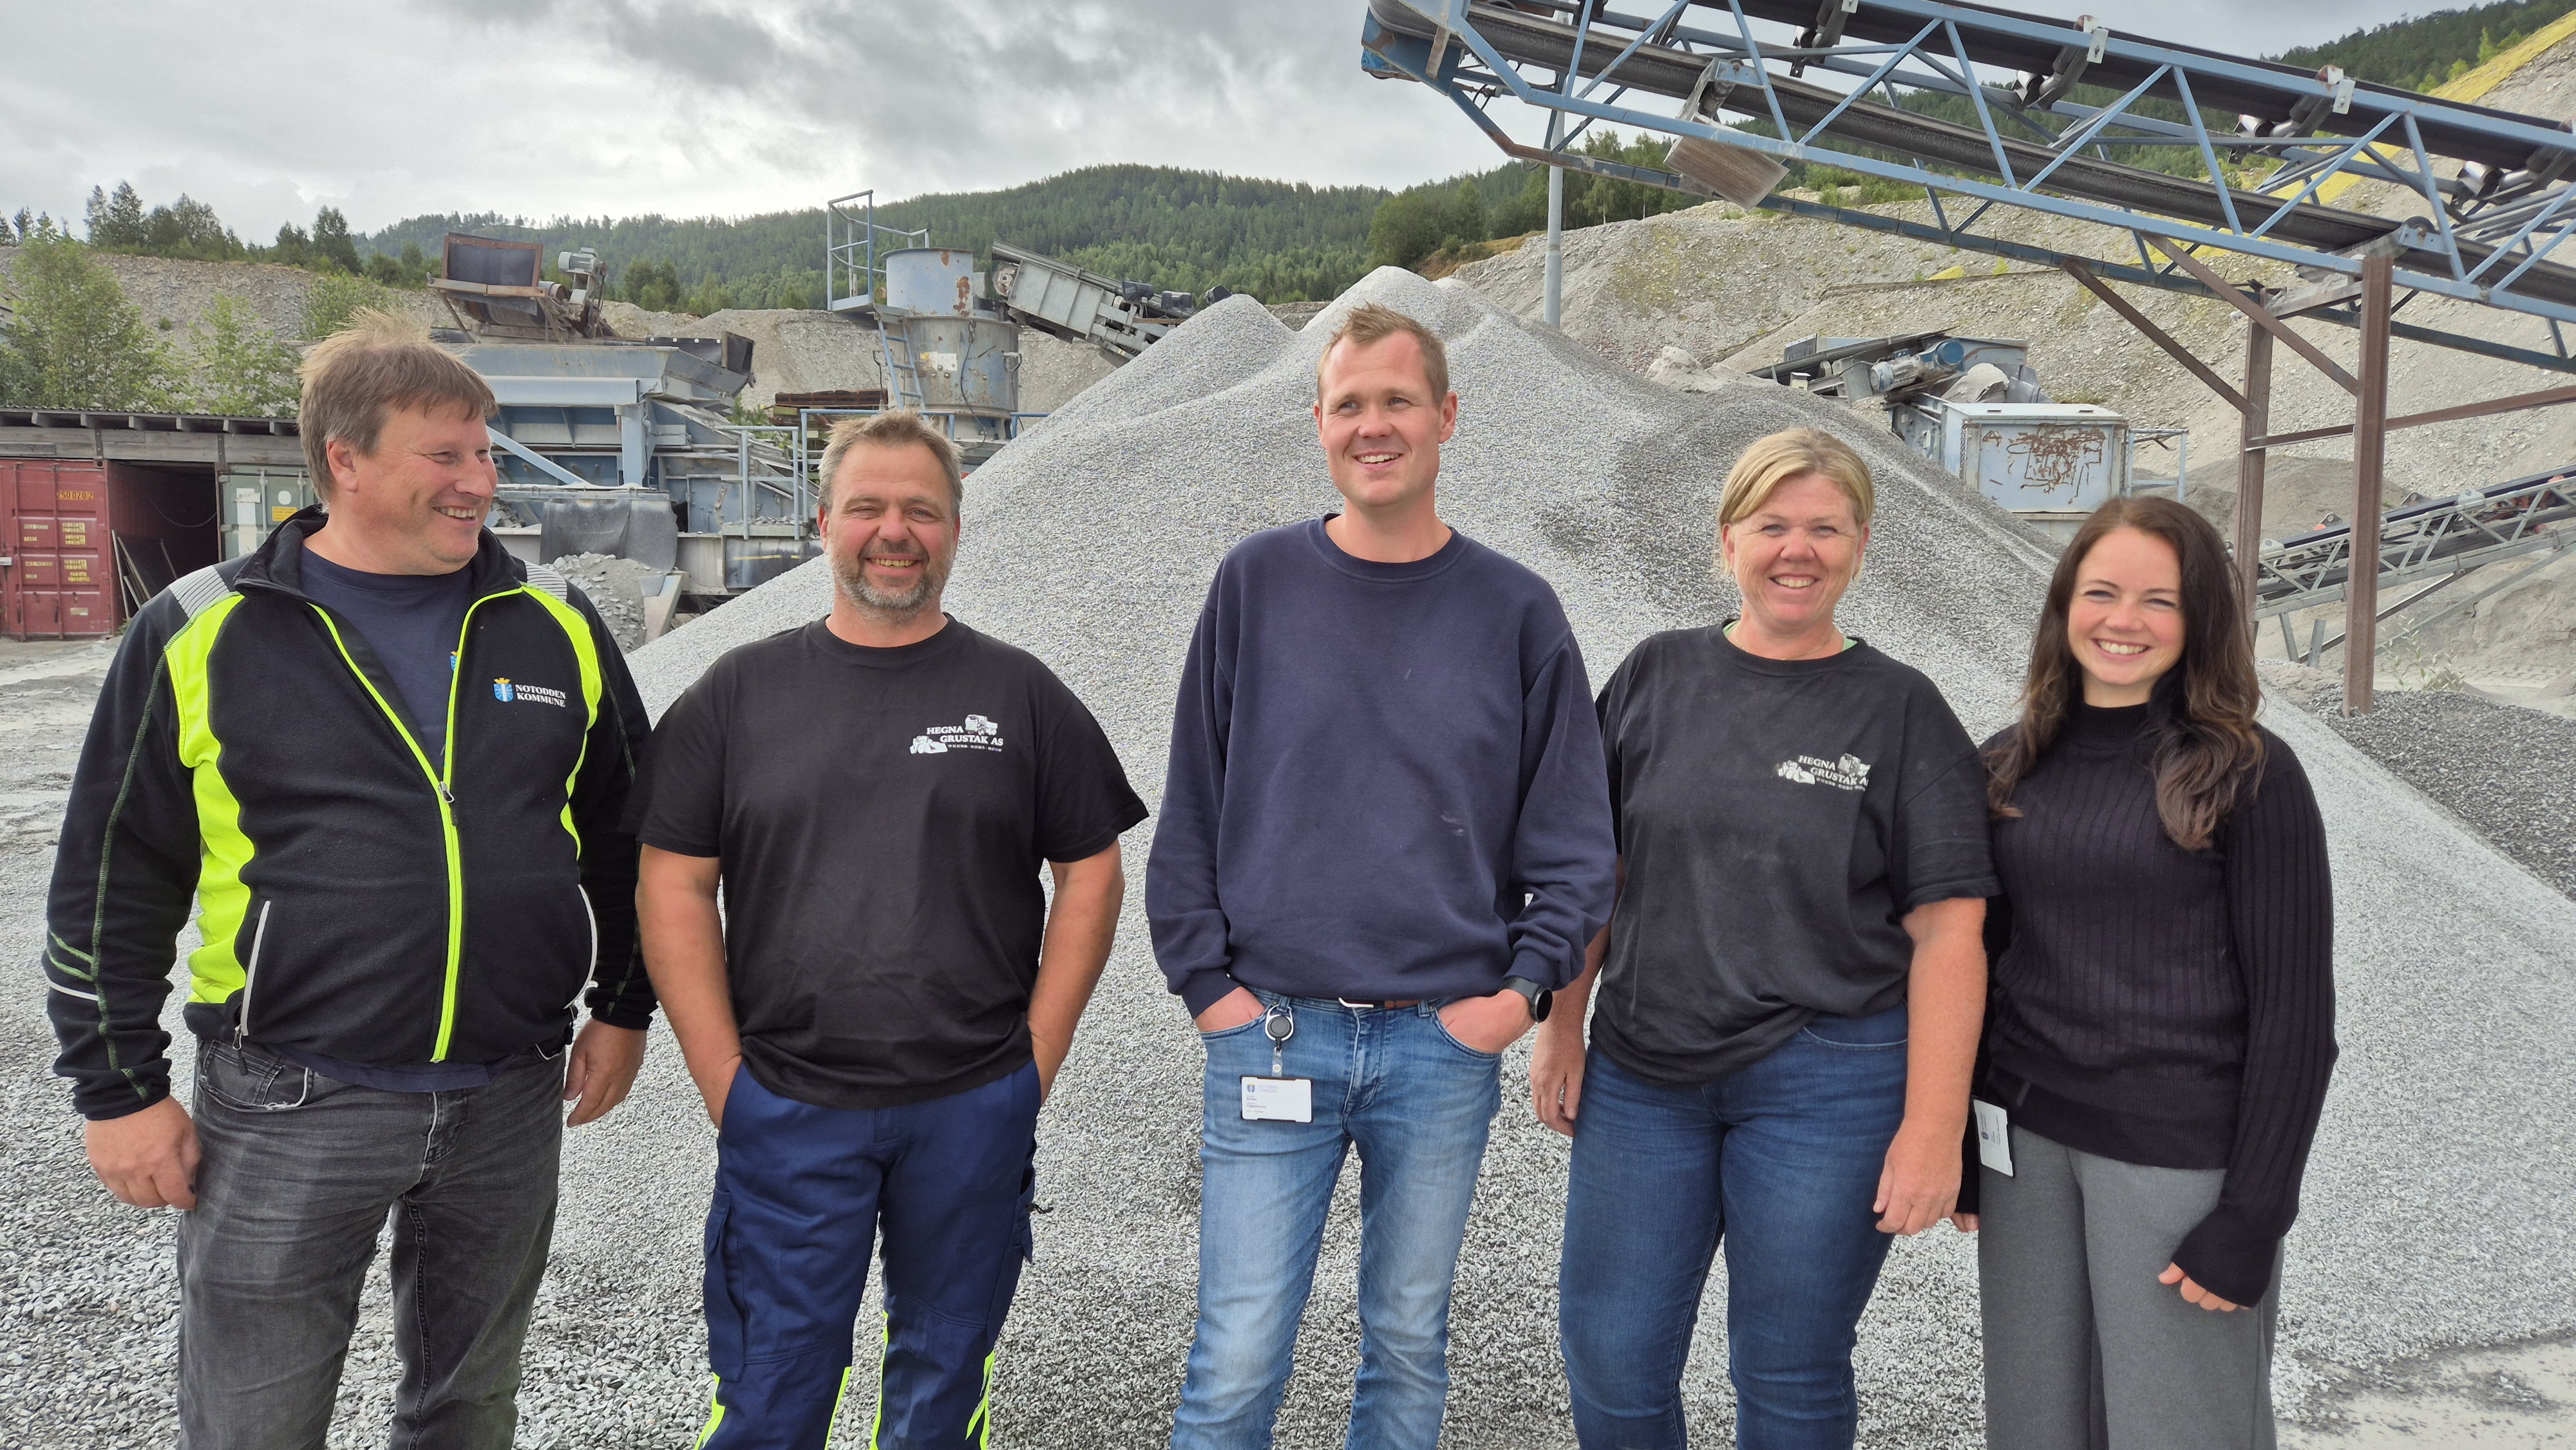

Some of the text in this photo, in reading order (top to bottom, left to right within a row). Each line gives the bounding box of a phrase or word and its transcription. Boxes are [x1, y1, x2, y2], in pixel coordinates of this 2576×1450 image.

[515, 684, 566, 699] NOTODDEN
[516, 692, 566, 708] KOMMUNE
[926, 726, 965, 735] HEGNA
[940, 735, 1004, 746] GRUSTAK AS
[1798, 755, 1836, 771] HEGNA
[1810, 767, 1857, 786] GRUSTAK
[1858, 776, 1869, 787] A
